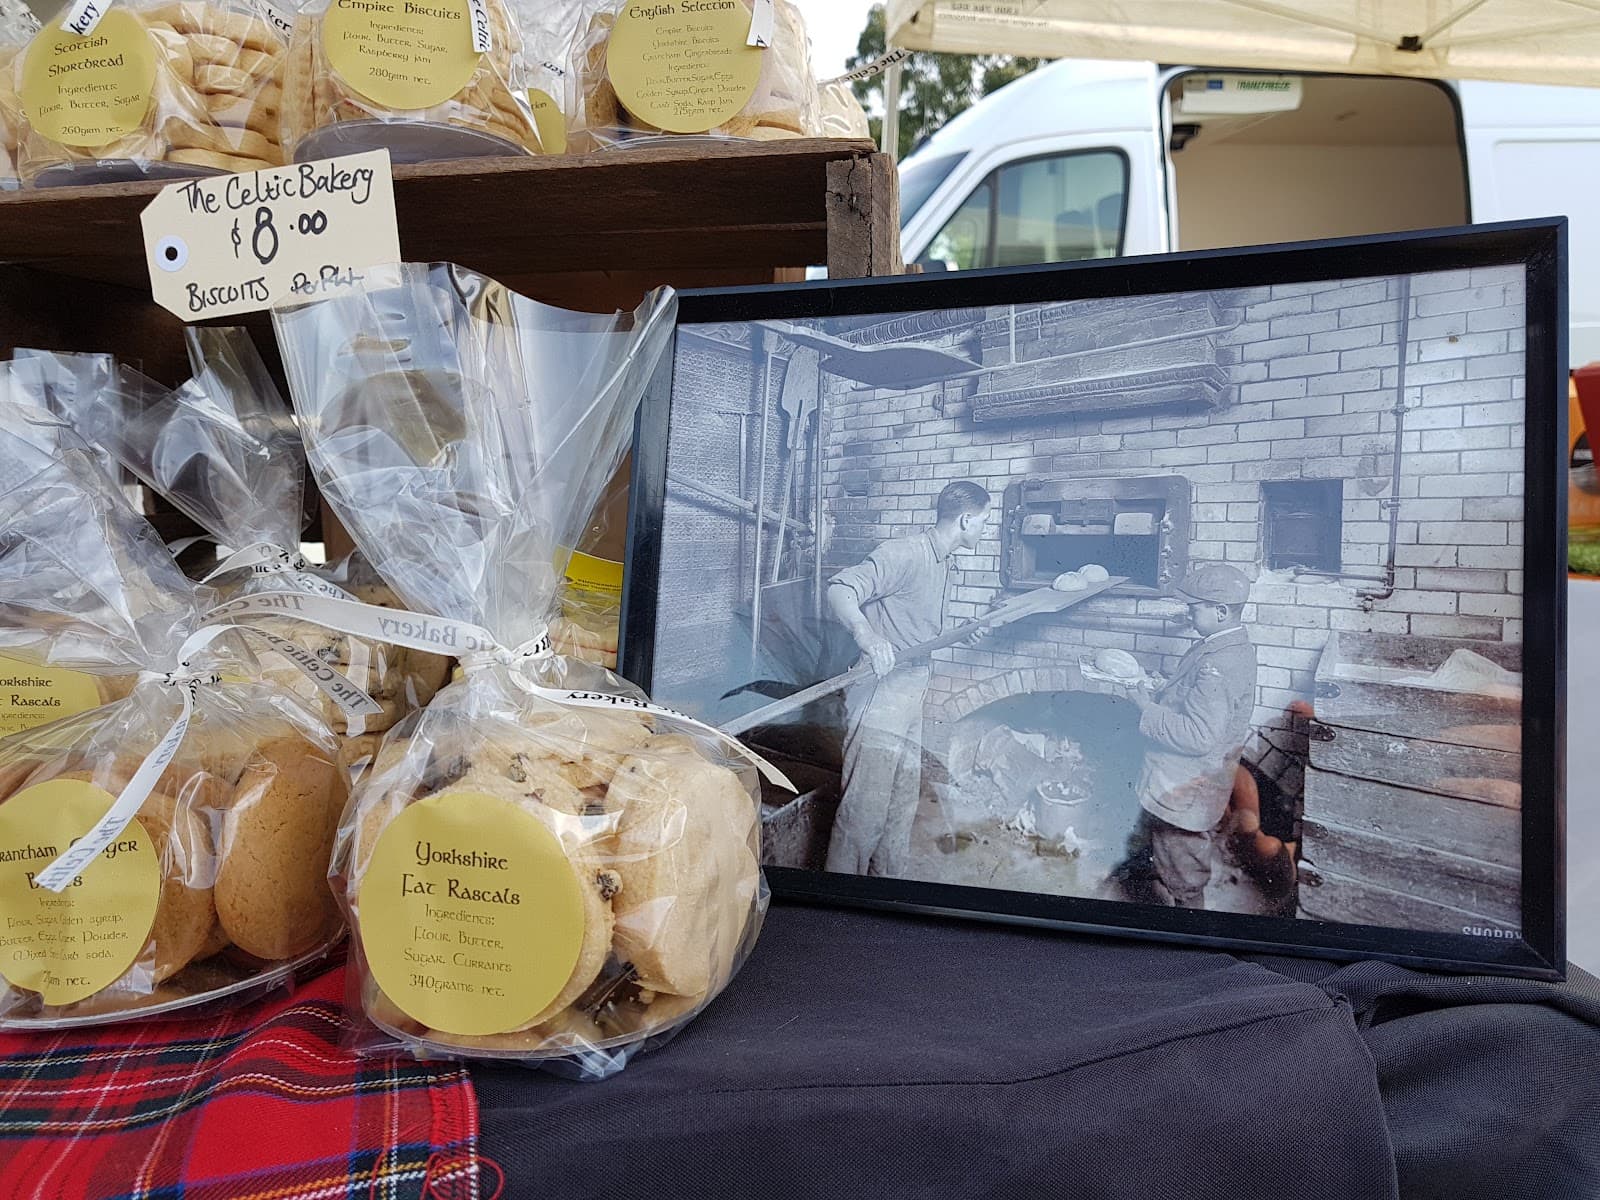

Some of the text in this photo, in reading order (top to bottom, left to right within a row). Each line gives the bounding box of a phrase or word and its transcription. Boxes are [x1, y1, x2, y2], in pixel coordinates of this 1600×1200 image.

[337, 0, 461, 20] Empire Biscuits
[629, 0, 736, 20] English Selection
[54, 36, 108, 56] Scottish
[48, 54, 124, 78] Shortbread
[177, 162, 374, 213] The Celtic Bakery
[11, 694, 61, 707] Rascals
[415, 841, 509, 871] Yorkshire
[401, 873, 521, 906] Fat Rascals
[425, 903, 496, 926] Ingredients:
[453, 952, 513, 973] Currants
[408, 974, 505, 997] 340grams net.
